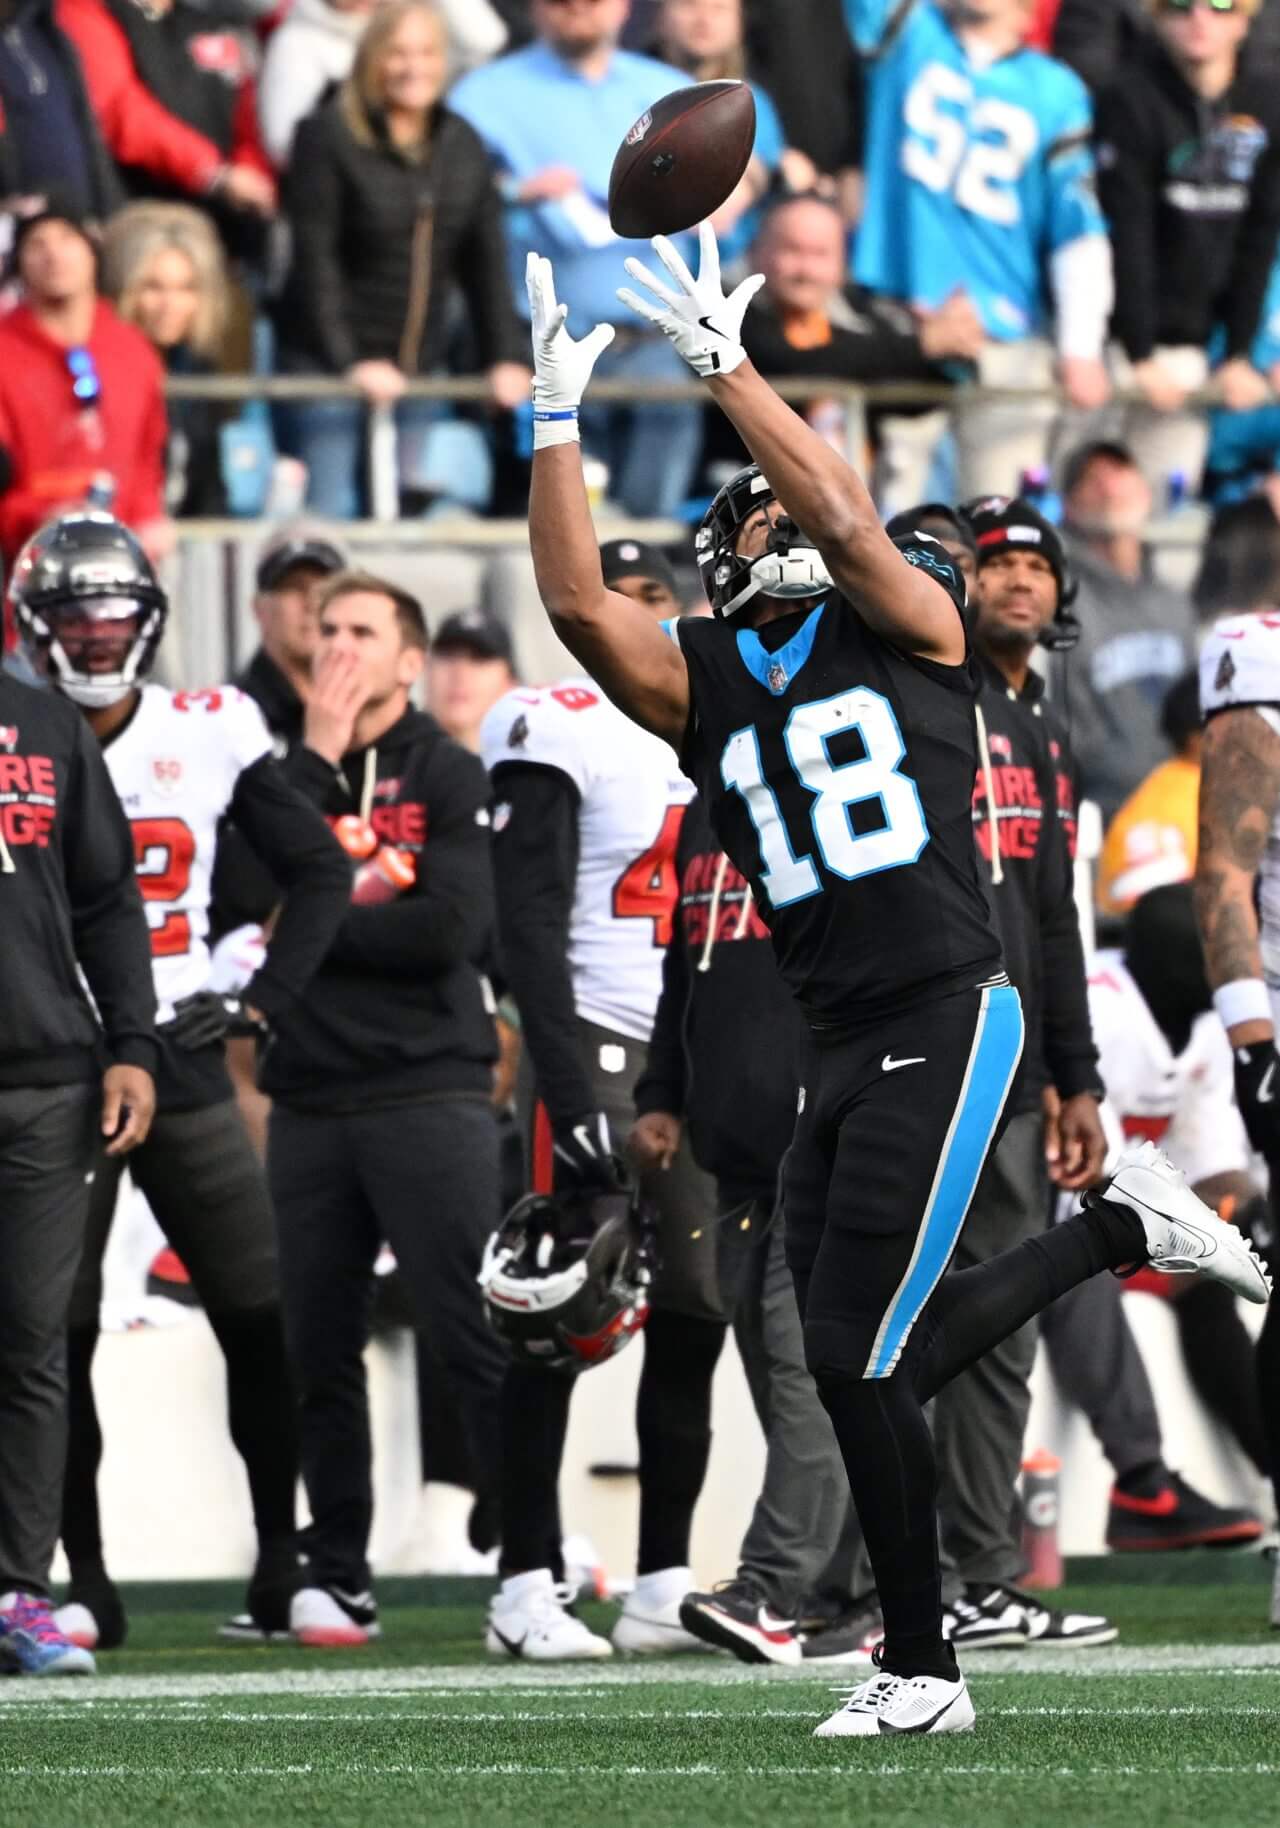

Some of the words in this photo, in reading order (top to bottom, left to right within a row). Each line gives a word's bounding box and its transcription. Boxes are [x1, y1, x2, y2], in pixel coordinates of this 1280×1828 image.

[626, 113, 651, 143] NFL
[901, 62, 1038, 224] 52
[721, 685, 930, 910] 18
[611, 804, 687, 948] 4
